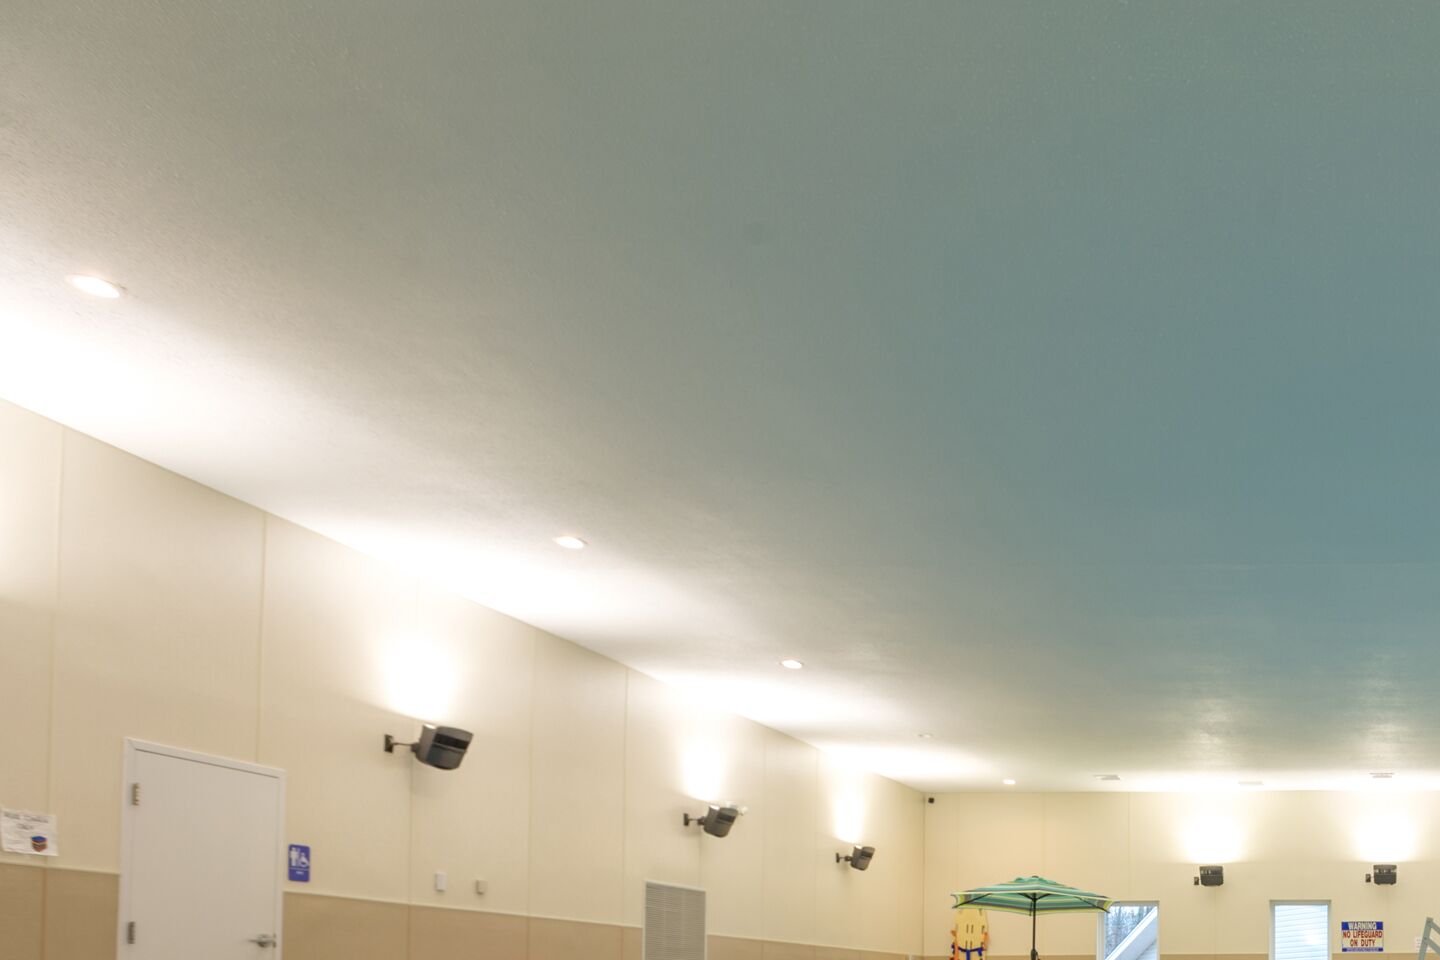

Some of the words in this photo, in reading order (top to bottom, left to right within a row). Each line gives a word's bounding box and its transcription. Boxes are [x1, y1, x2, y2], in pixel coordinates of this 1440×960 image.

[1348, 922, 1376, 930] WARNING
[1350, 939, 1358, 947] ON
[1361, 939, 1376, 947] DUTY
